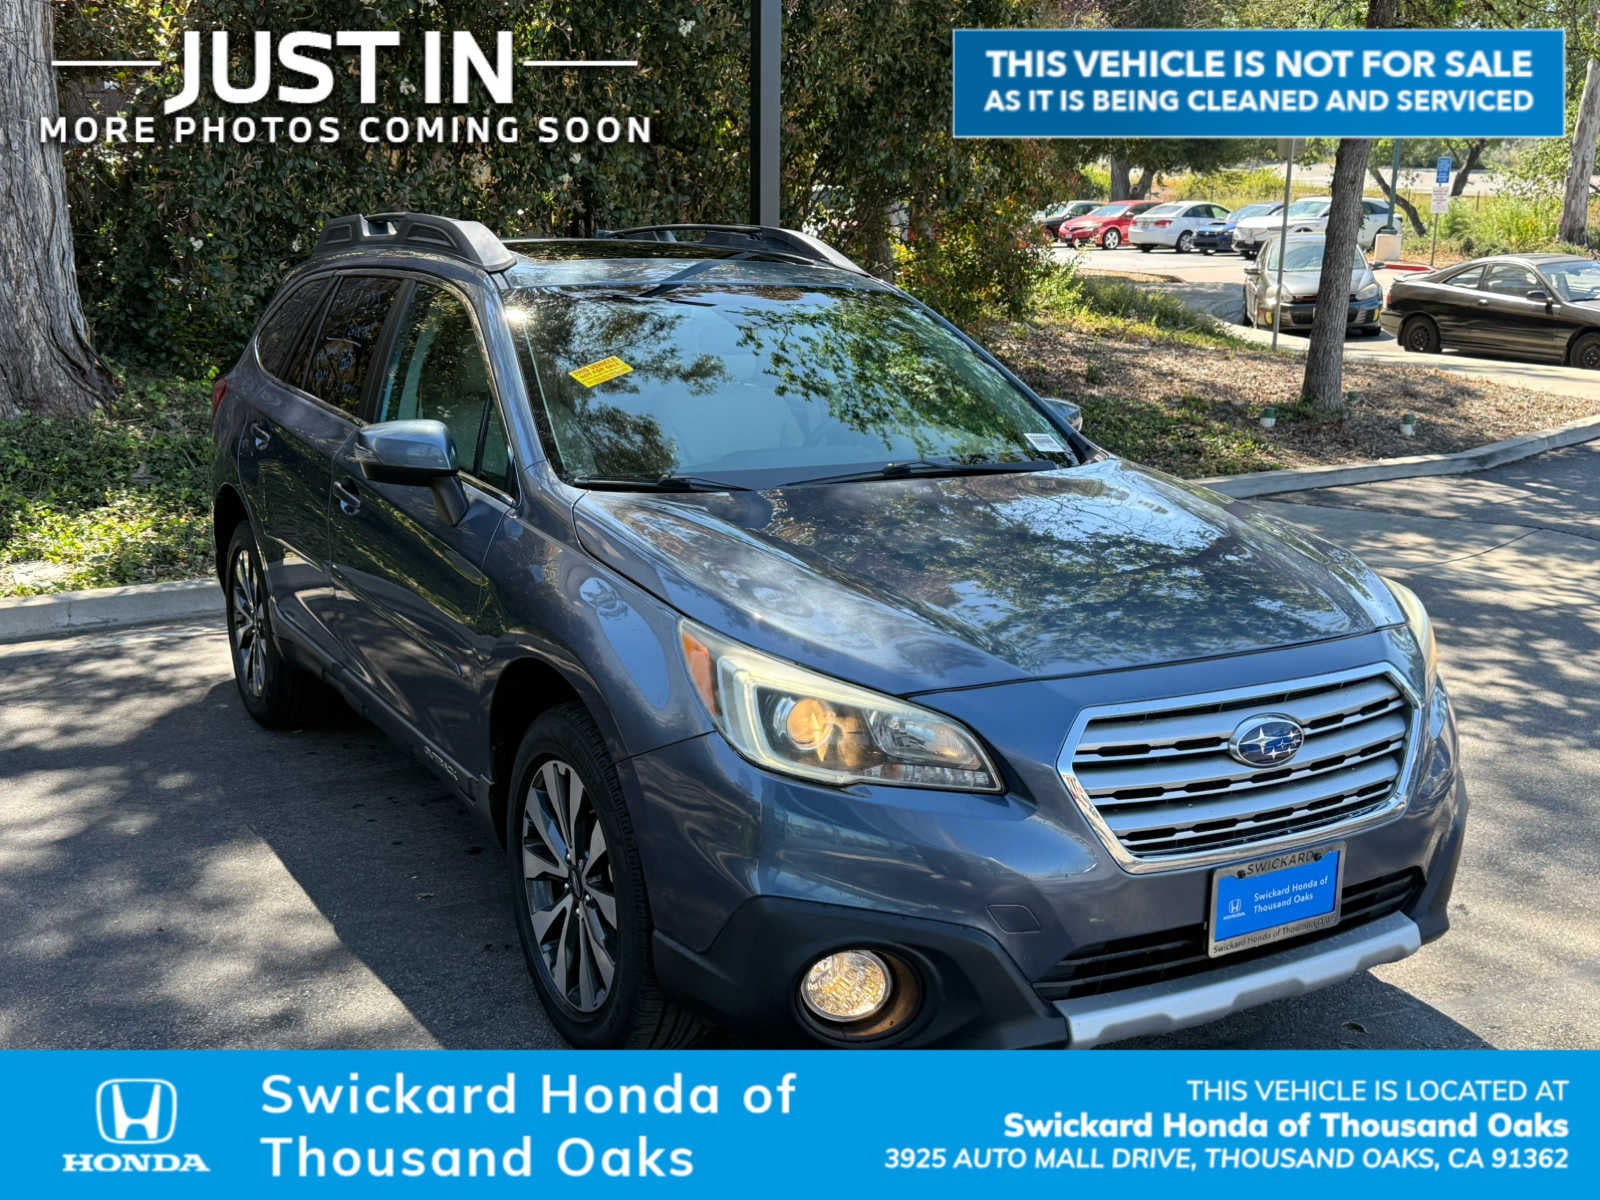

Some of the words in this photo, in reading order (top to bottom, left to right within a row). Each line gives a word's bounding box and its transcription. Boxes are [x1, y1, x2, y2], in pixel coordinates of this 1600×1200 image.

[1247, 850, 1315, 875] SWICKARD
[1254, 885, 1290, 902] Swickard
[1292, 880, 1318, 892] Honda
[1320, 875, 1328, 885] of
[1254, 897, 1292, 913] Thousand
[1293, 892, 1313, 904] Oaks
